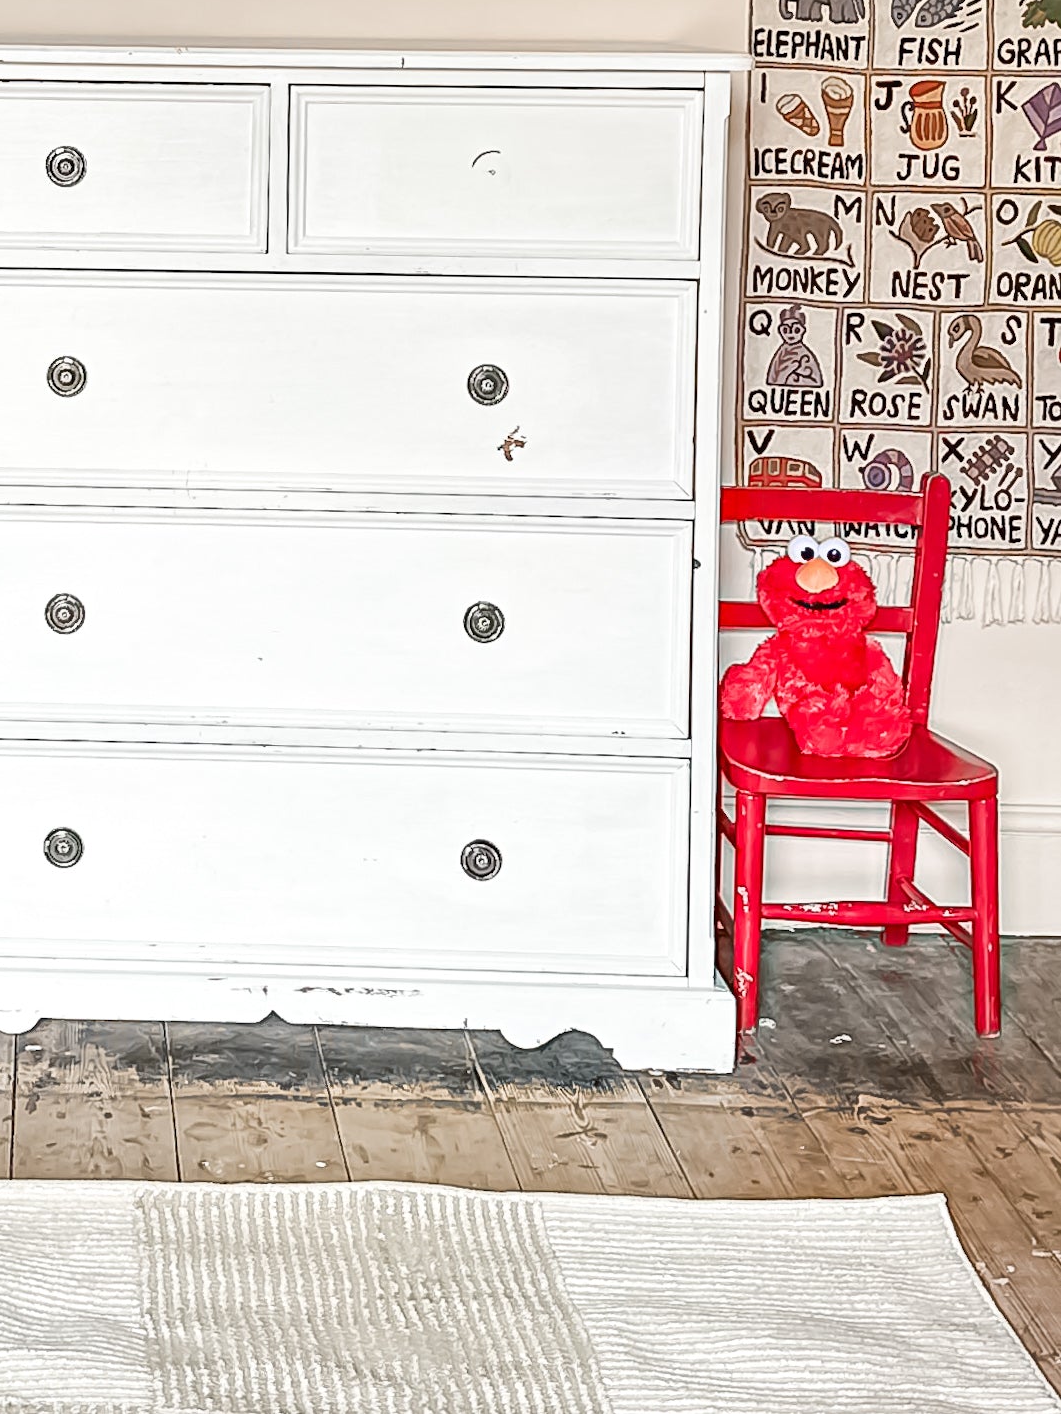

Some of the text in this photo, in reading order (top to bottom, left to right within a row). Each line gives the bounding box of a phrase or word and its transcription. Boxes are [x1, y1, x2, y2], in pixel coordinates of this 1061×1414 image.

[753, 28, 866, 62] ELEPHANT
[897, 37, 963, 66] FISH
[760, 72, 767, 103] I
[875, 80, 903, 111] J
[996, 80, 1018, 114] K
[754, 148, 864, 180] ICECREAM
[896, 153, 961, 181] JUG
[834, 194, 863, 224] M
[875, 196, 897, 226] N
[996, 198, 1019, 225] O
[752, 265, 861, 298] MONKEY
[891, 270, 971, 300] NEST
[748, 310, 772, 336] Q
[845, 313, 865, 345] R
[1001, 314, 1022, 345] S
[1040, 317, 1061, 347] T
[748, 389, 831, 419] QUEEN
[849, 392, 922, 421] ROSE
[943, 392, 1020, 422] SWAN
[747, 430, 775, 455] V
[843, 433, 875, 462] W
[941, 437, 965, 463] X
[1039, 438, 1061, 470] Y
[950, 483, 1026, 512] YLO-
[843, 522, 917, 539] WATC
